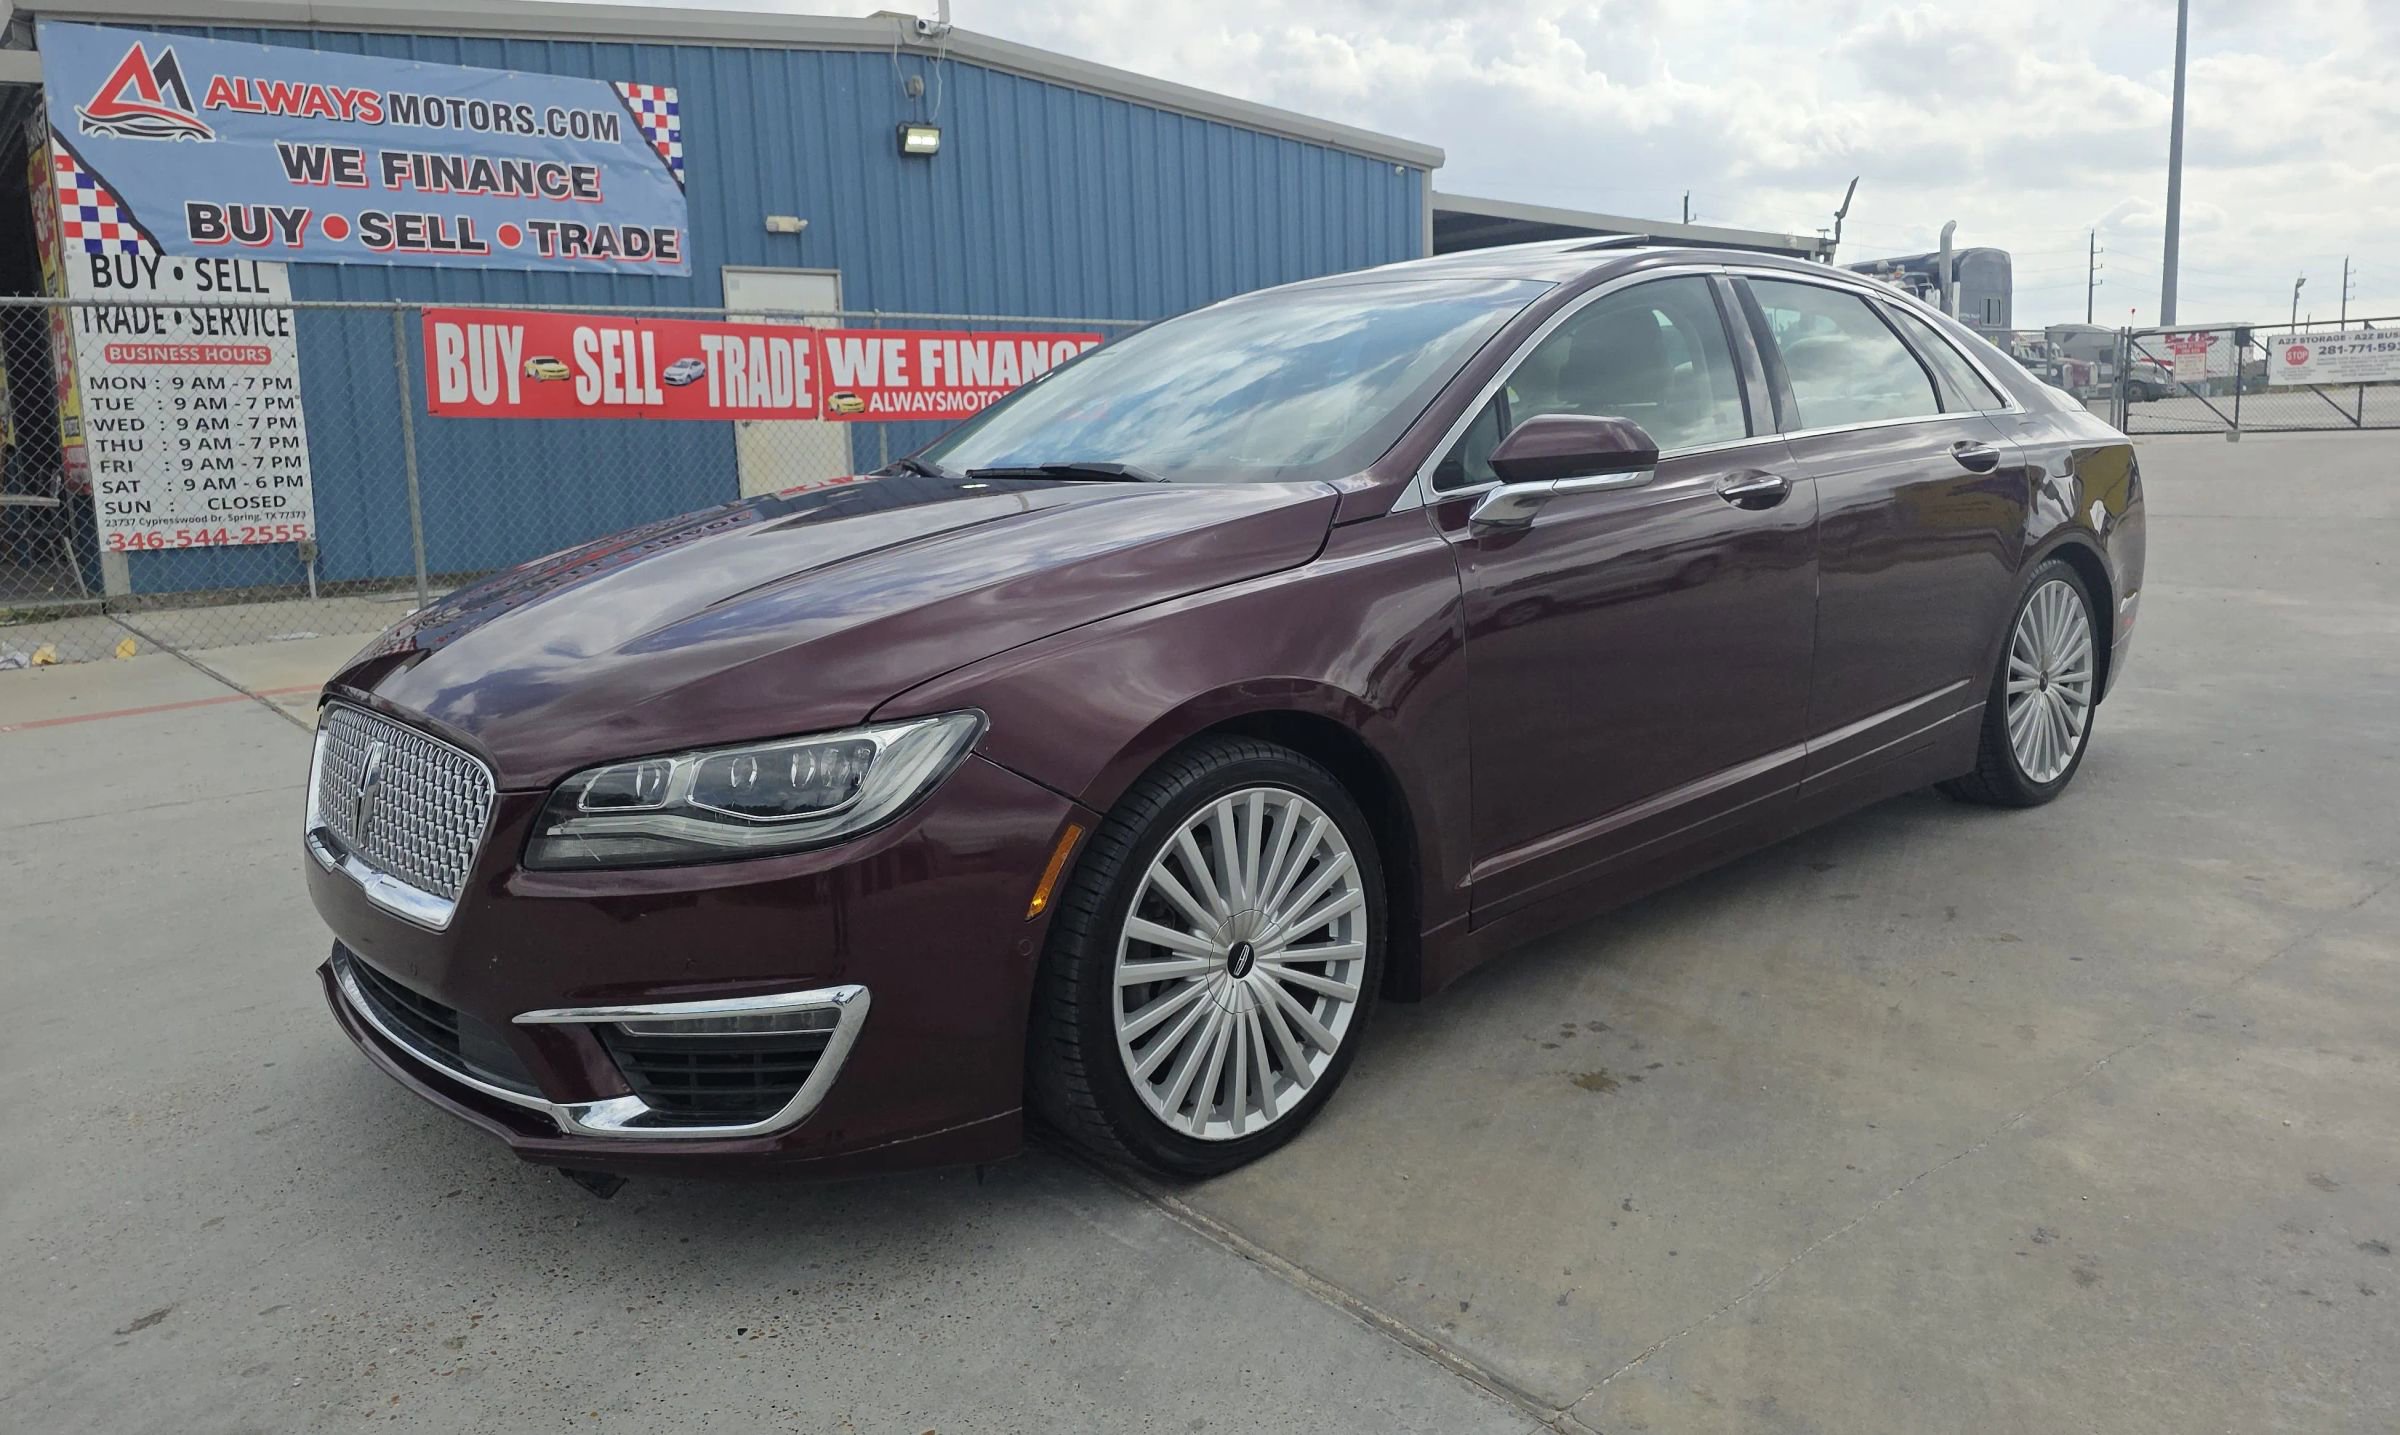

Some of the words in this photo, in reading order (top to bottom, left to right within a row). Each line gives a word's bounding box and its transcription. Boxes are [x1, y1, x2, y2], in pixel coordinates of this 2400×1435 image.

[275, 141, 370, 188] WE
[380, 149, 602, 202] FINANCE
[185, 201, 308, 247] BUY
[358, 211, 491, 255] SELL
[528, 219, 682, 263] TRADE
[91, 254, 160, 289] BUY
[195, 258, 270, 293] SELL
[191, 308, 289, 336] SERVICE
[2301, 335, 2346, 344] STORAGE
[109, 346, 200, 361] BUSINESS
[205, 349, 267, 363] HOURS
[825, 337, 909, 387] WE
[919, 339, 1100, 388] FINAN
[2287, 350, 2308, 360] STOP
[434, 322, 525, 406] BUY
[572, 326, 664, 406] SELL
[700, 334, 813, 409] TRADE
[90, 377, 146, 390] MON
[172, 377, 184, 390] 9
[191, 377, 225, 390] AM
[244, 377, 255, 390] 7
[263, 377, 293, 389] PM
[91, 398, 135, 410] TUE
[174, 397, 186, 410] 9
[193, 398, 227, 410] AM
[246, 398, 257, 410] 7
[264, 397, 295, 409] PM
[869, 391, 1011, 412] ALWAYSMOTO
[93, 419, 145, 431] WED
[176, 418, 189, 430] 9
[195, 418, 229, 430] AM
[248, 417, 260, 429] 7
[267, 417, 297, 429] PM
[96, 440, 143, 452] THU
[179, 438, 191, 450] 9
[198, 438, 232, 450] AM
[250, 437, 262, 449] 7
[269, 437, 299, 449] PM
[100, 460, 133, 473] FRI
[181, 459, 193, 471] 9
[200, 458, 234, 470] AM
[253, 457, 265, 469] 7
[271, 456, 301, 468] PM
[102, 480, 140, 494] SAT
[183, 479, 196, 491] 9
[202, 478, 236, 491] AM
[255, 476, 267, 489] 6
[273, 475, 304, 488] PM
[105, 500, 152, 515] SUN
[207, 496, 287, 510] CLOSED
[105, 518, 136, 528] 23737
[139, 515, 208, 528] Cypresswood
[265, 512, 276, 520] TX
[279, 511, 307, 520] 77373
[109, 523, 307, 551] 346-544-2555
